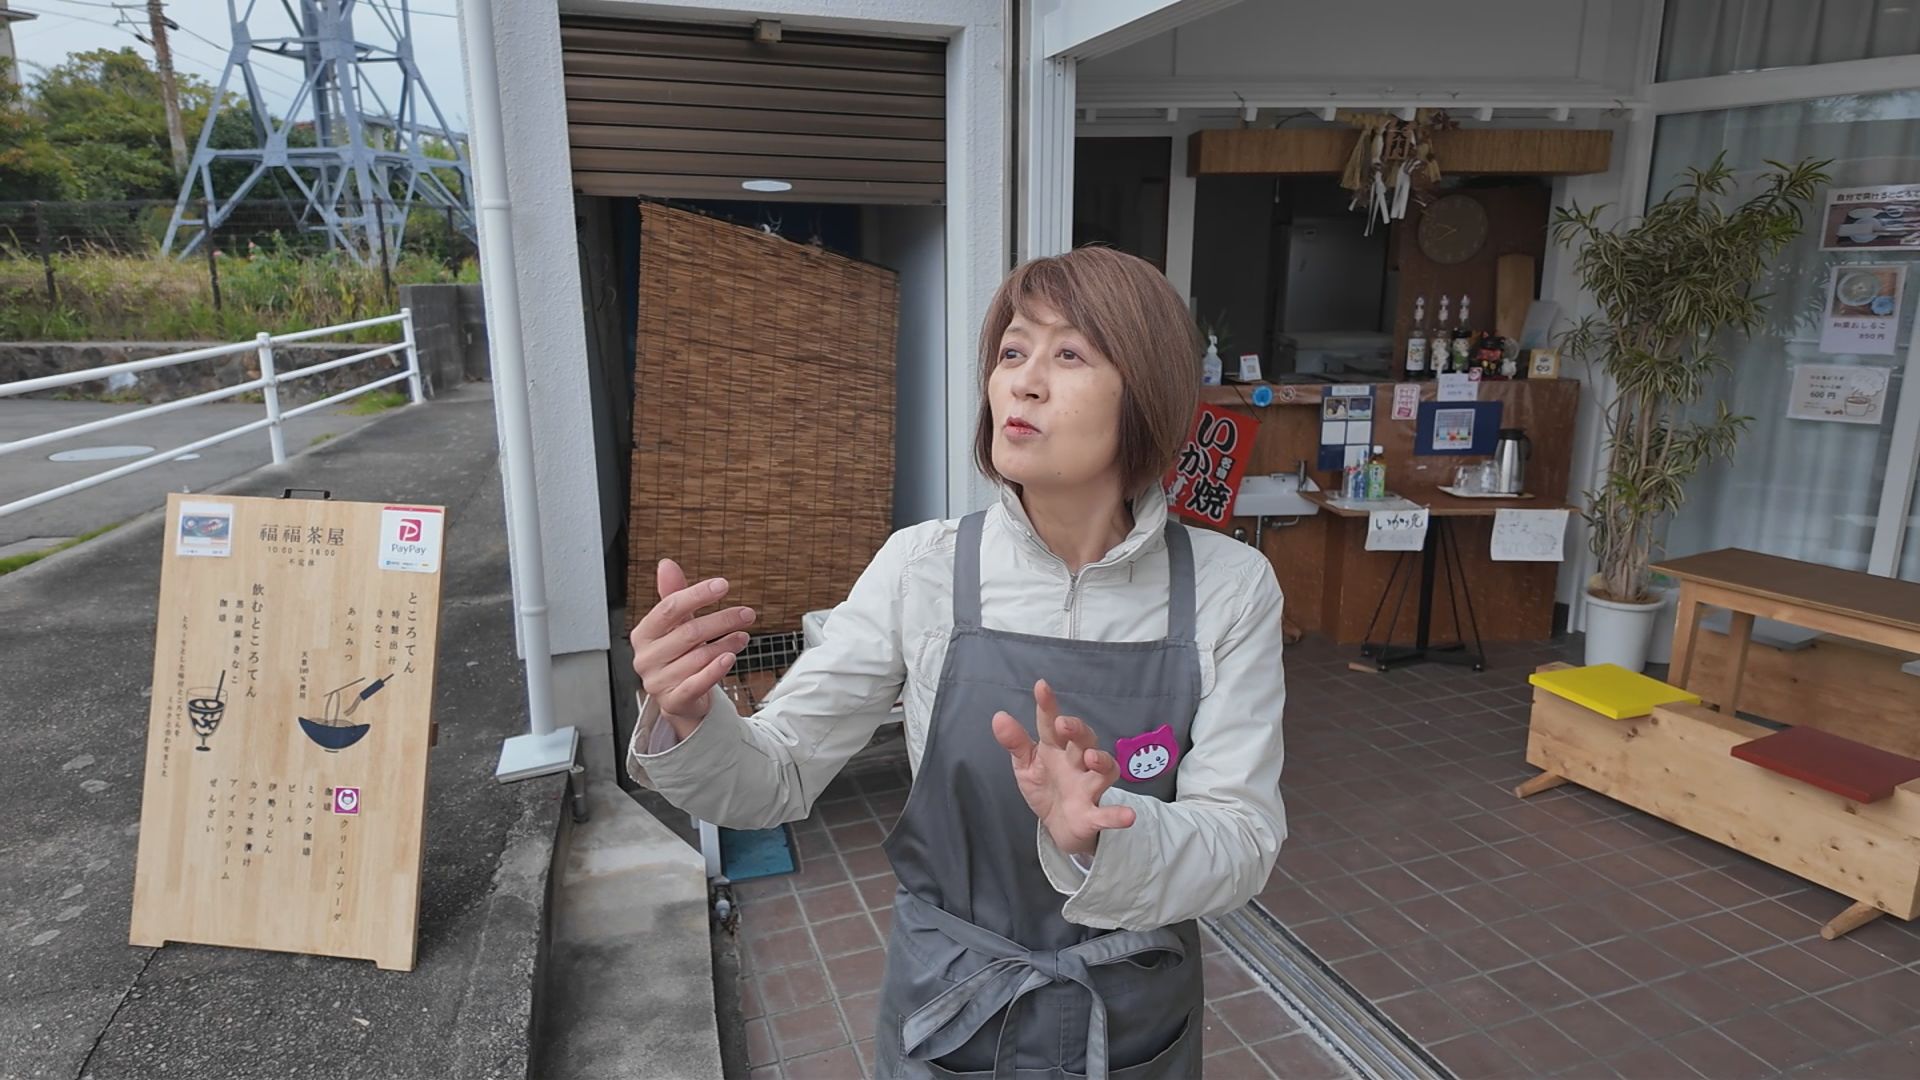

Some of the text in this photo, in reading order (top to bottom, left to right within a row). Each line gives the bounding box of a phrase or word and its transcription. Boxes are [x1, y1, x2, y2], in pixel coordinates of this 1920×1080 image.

[259, 524, 345, 546] 福福茶屋
[391, 543, 427, 556] PayPay
[218, 599, 229, 623] 珈琲
[344, 607, 357, 662] あんみつ
[374, 609, 384, 649] きなこ
[388, 610, 401, 665] 特製出汁
[403, 592, 418, 674] ところてん
[231, 600, 244, 684] 黒胡麻きなこ
[246, 583, 264, 698] 飲むところてん
[205, 778, 219, 833] ぜんざい
[264, 782, 278, 854] 伊勢うどん
[286, 784, 296, 823] ビール
[302, 785, 315, 856] ミルク珈琲
[323, 787, 334, 811] 珈琲
[221, 779, 239, 880] アイスクリーム
[334, 819, 348, 921] クリームソーダ
